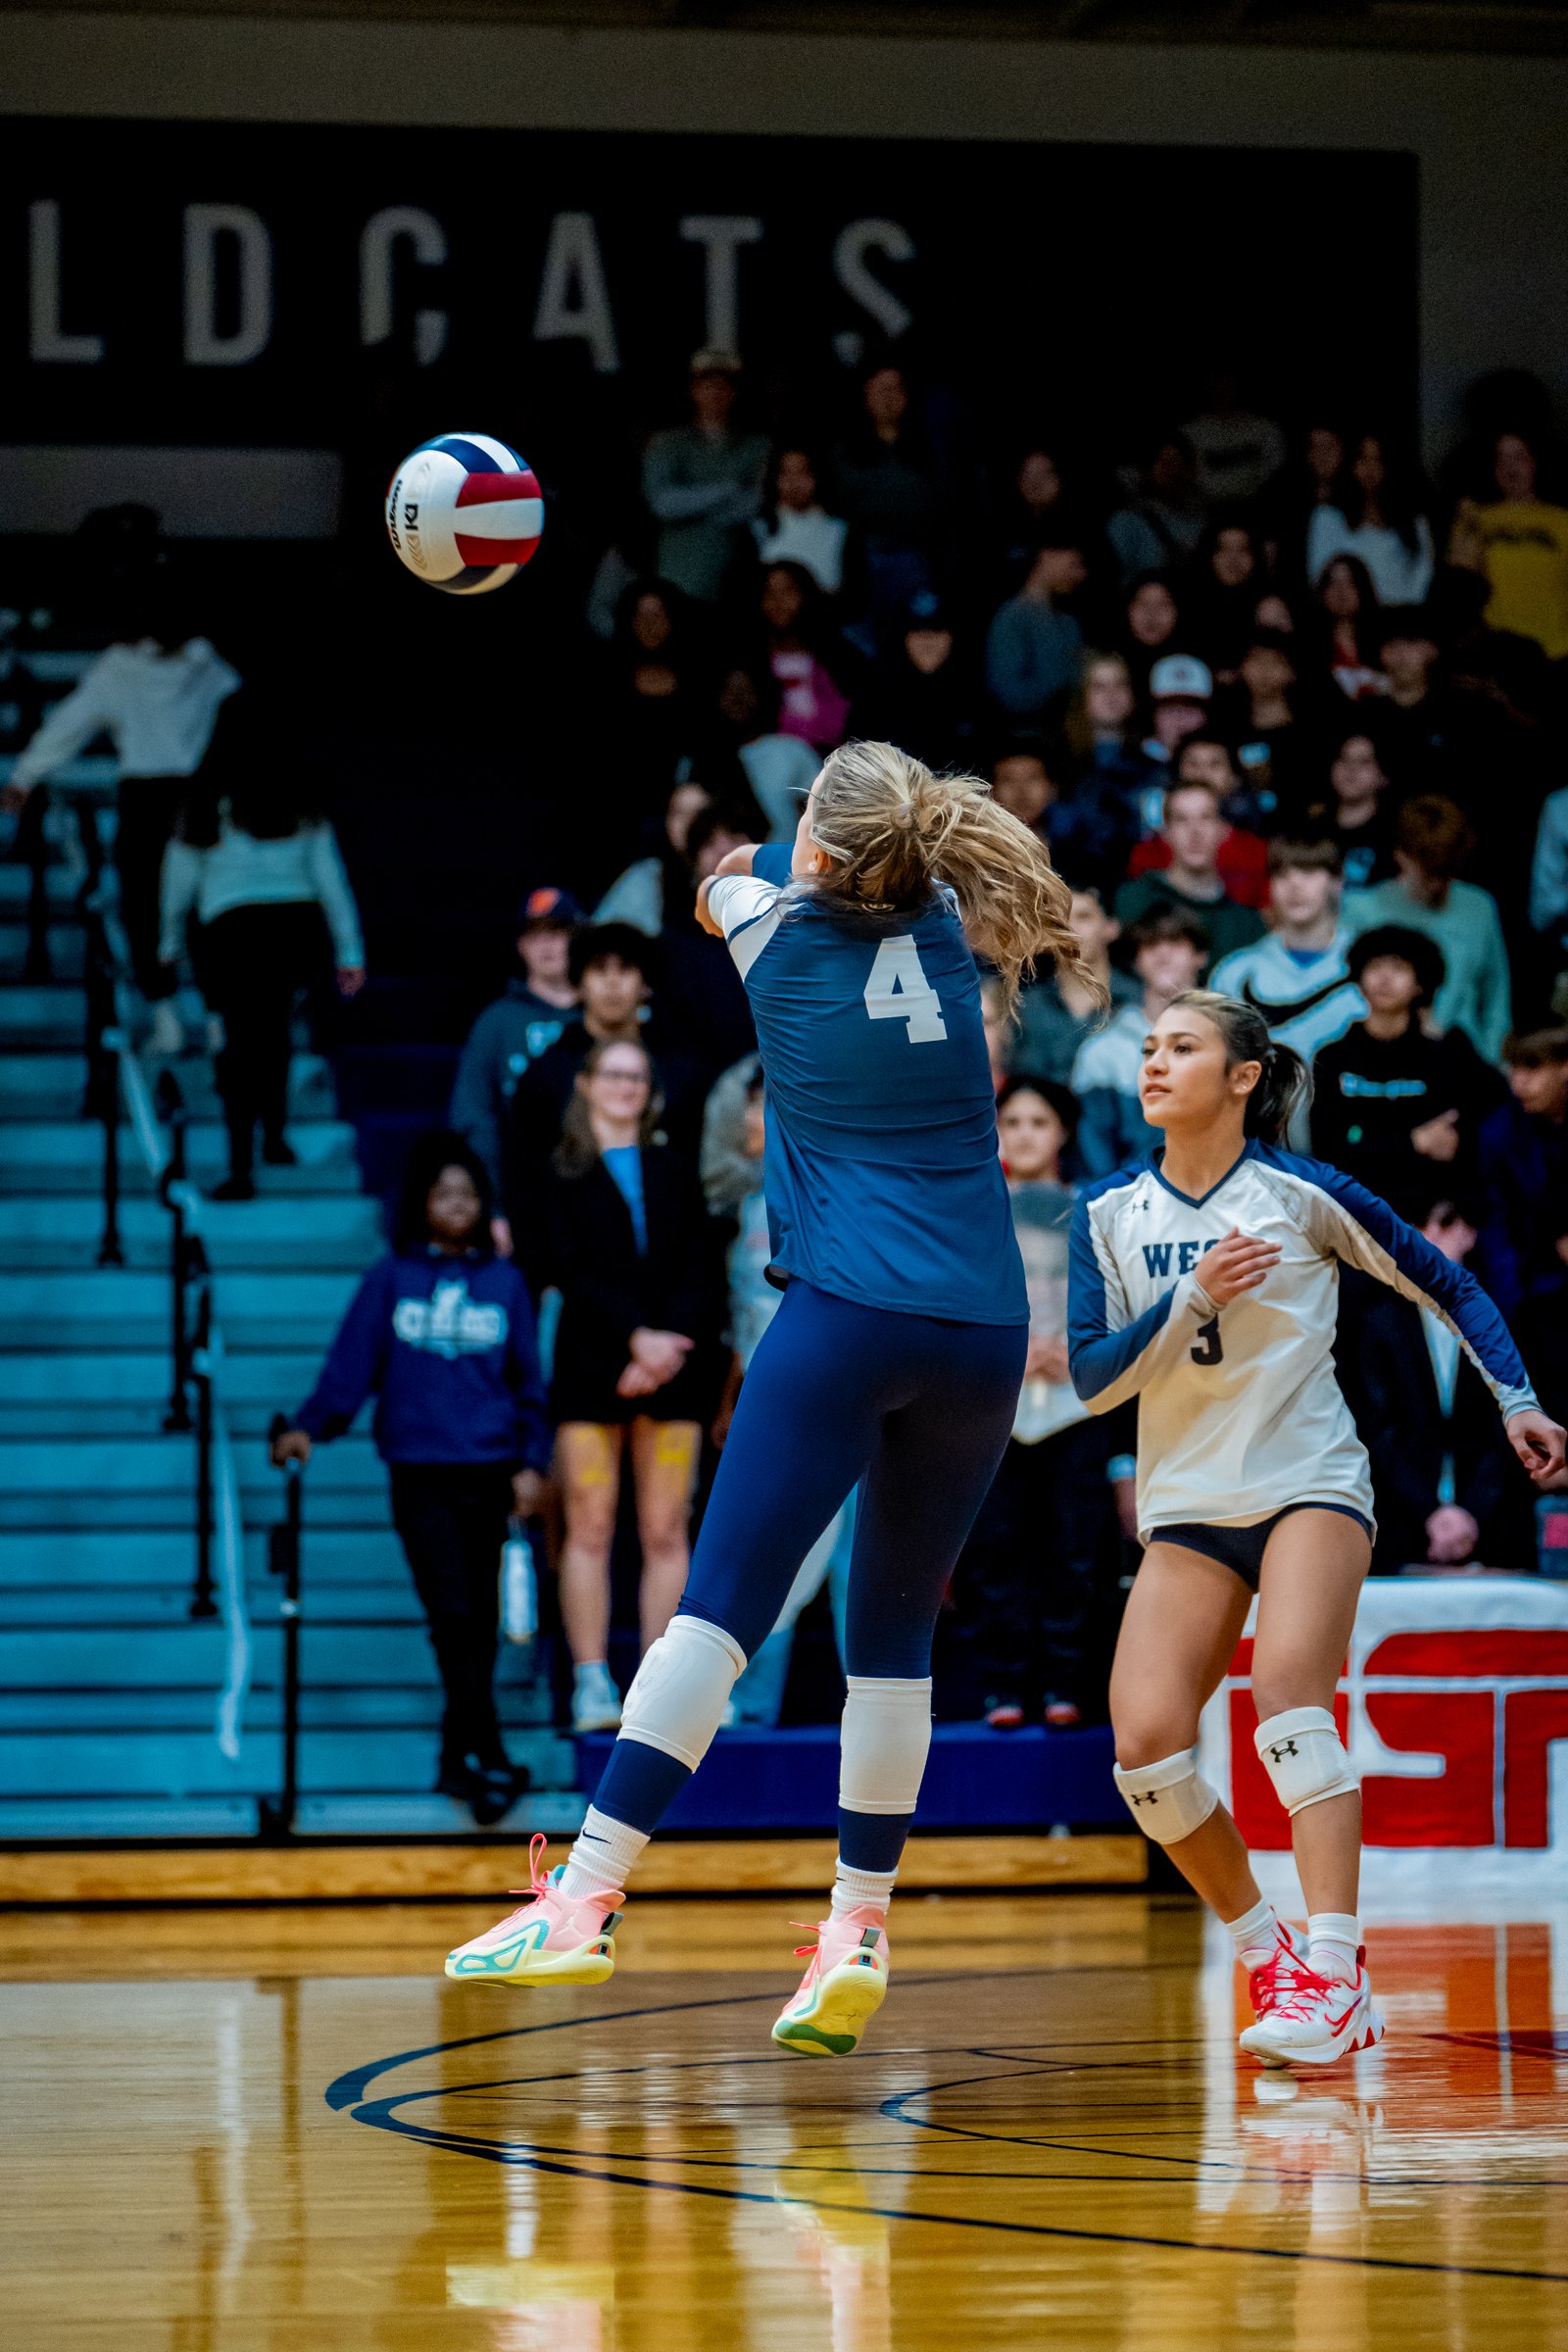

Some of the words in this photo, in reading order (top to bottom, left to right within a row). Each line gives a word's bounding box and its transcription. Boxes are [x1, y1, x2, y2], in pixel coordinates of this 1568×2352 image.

[863, 934, 948, 1044] 4
[1143, 1239, 1222, 1279] WE
[1191, 1311, 1224, 1366] 3
